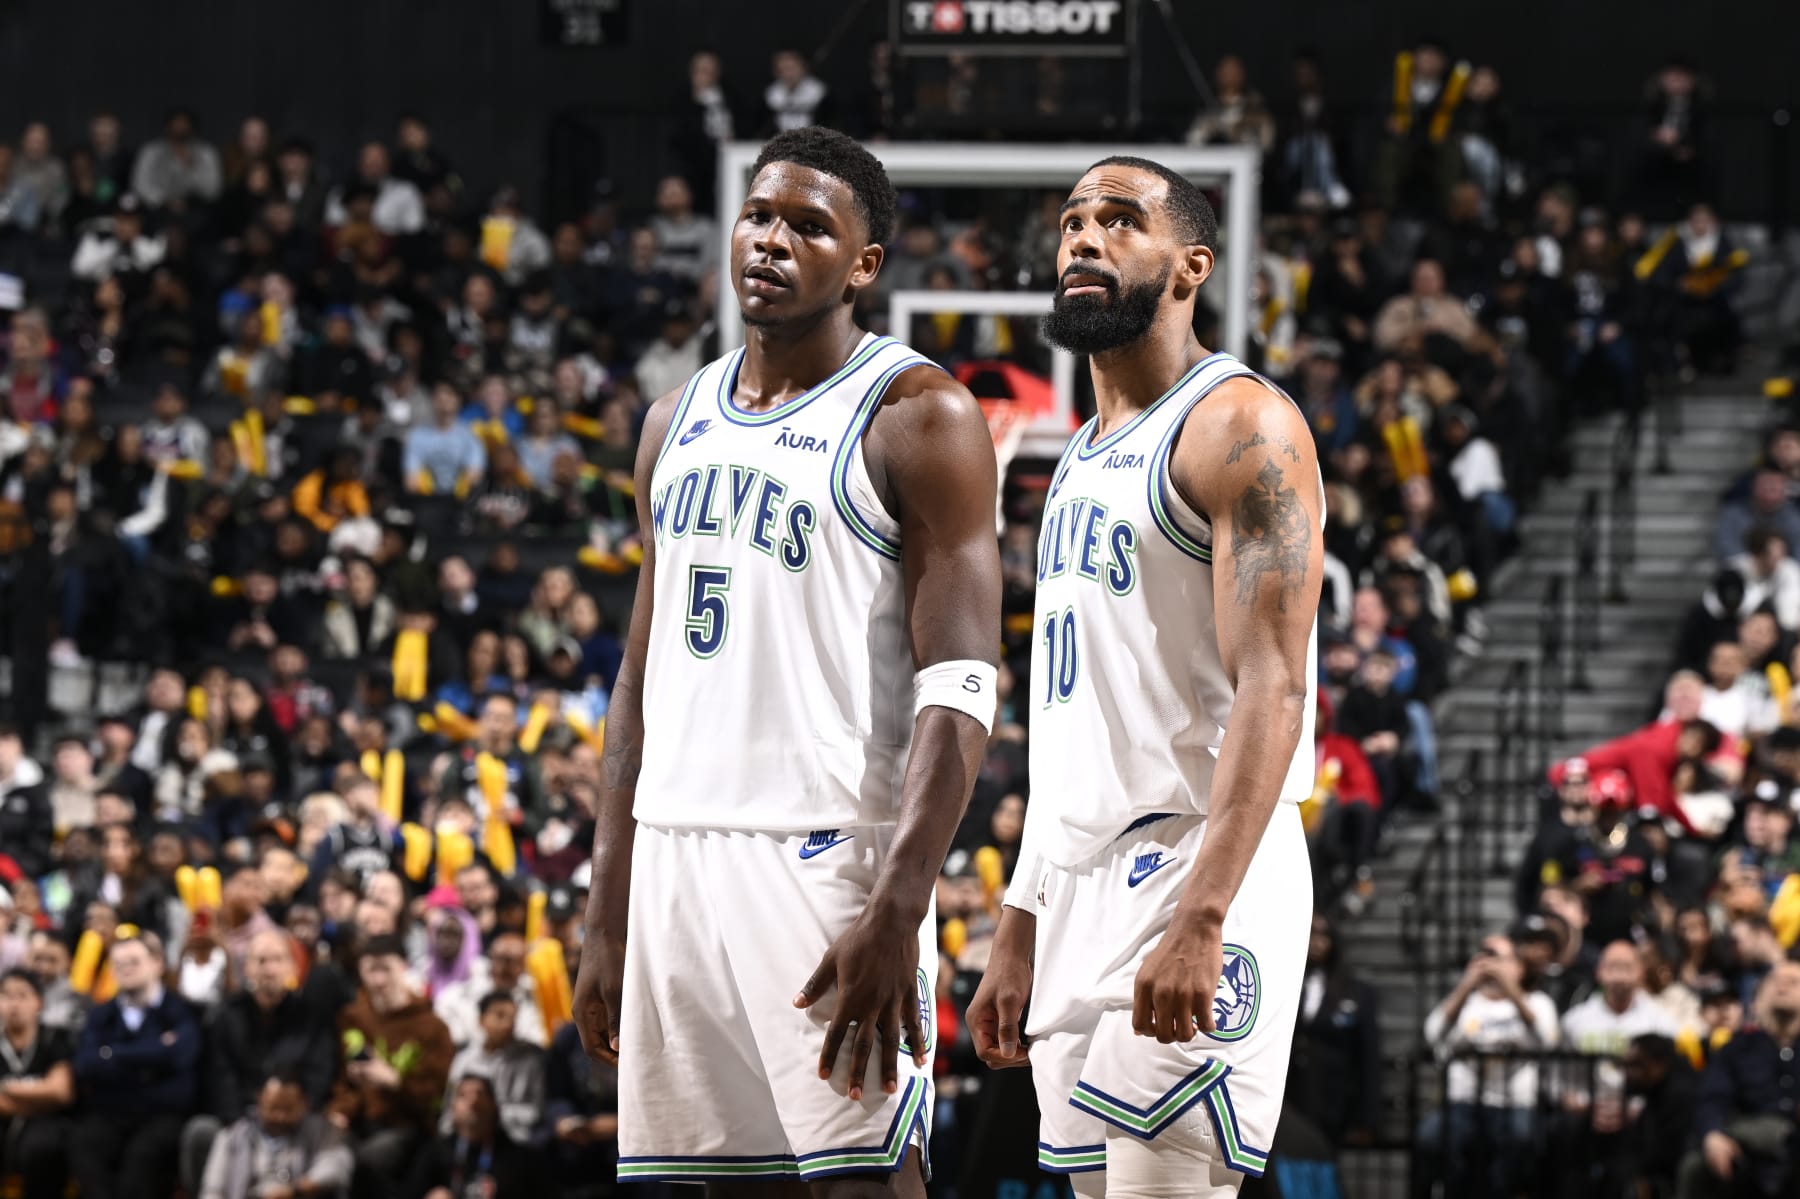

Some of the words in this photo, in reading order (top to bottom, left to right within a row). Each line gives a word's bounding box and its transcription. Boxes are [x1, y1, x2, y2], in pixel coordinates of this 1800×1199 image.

[966, 0, 1121, 33] TISSOT
[653, 463, 817, 573] WOLVES
[685, 564, 732, 660] 5
[1043, 605, 1079, 710] 10
[961, 673, 982, 693] 5
[807, 828, 841, 847] NIKE
[1134, 851, 1164, 874] NIKE
